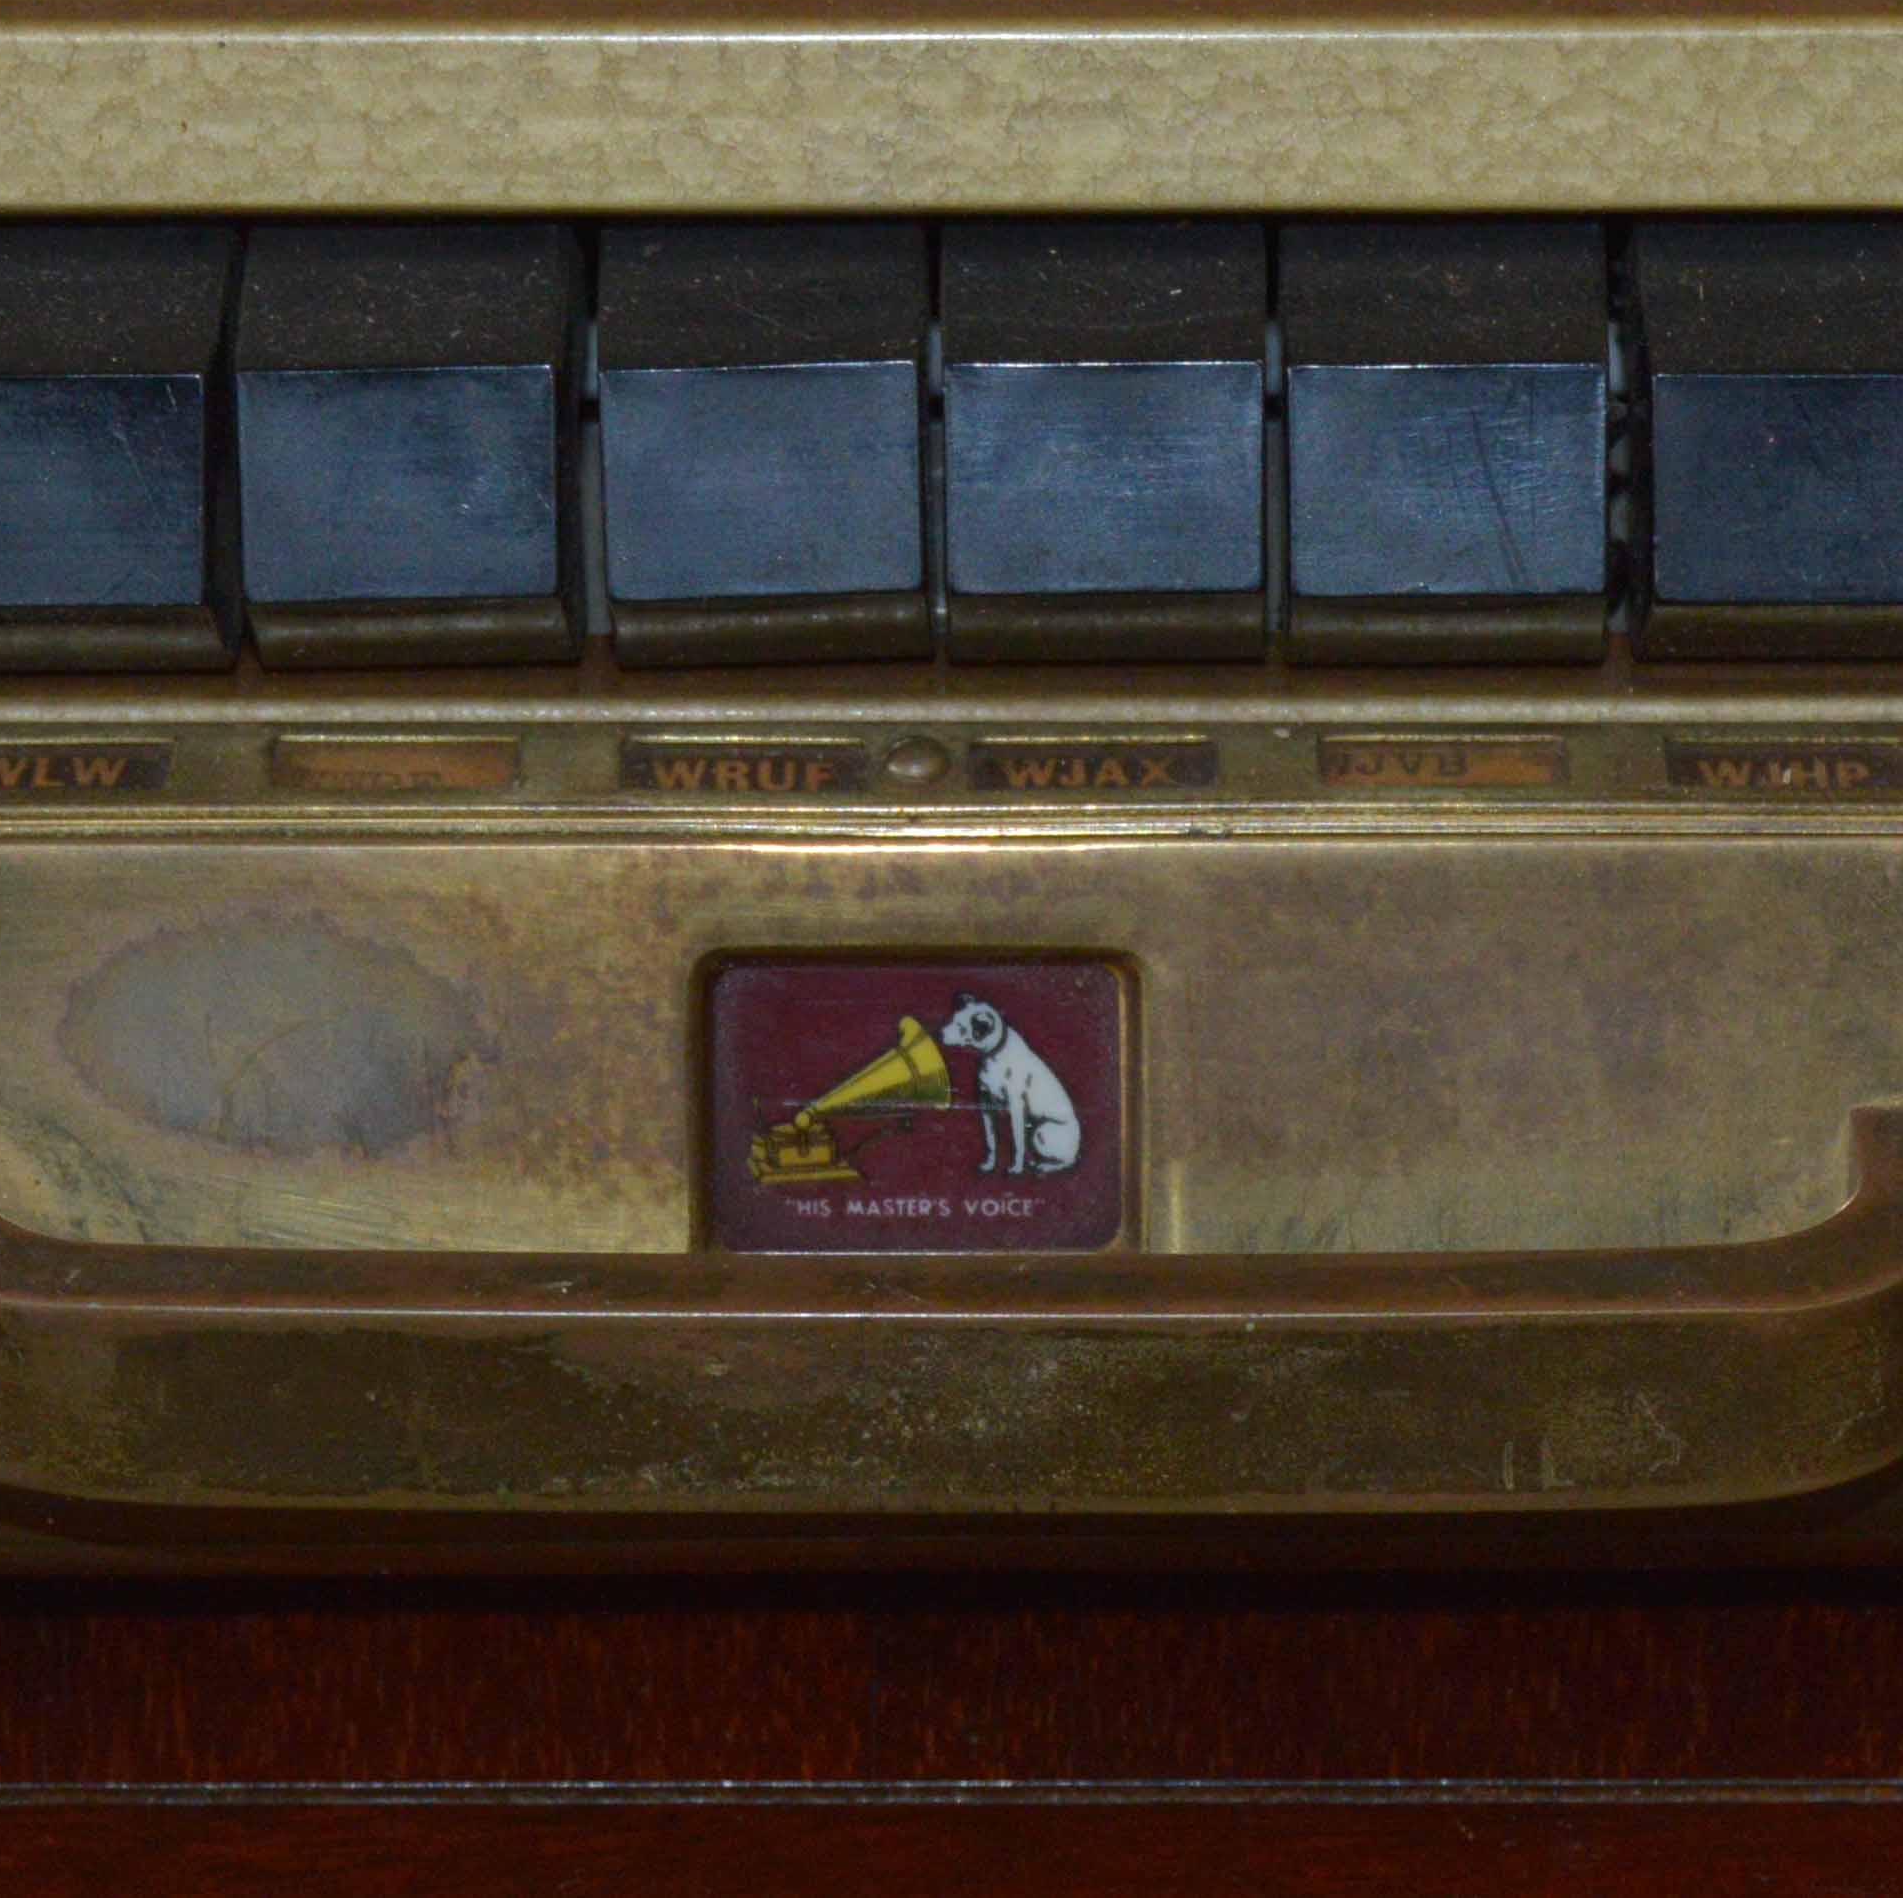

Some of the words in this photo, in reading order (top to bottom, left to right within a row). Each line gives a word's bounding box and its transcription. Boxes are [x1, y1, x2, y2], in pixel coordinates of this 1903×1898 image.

[651, 757, 837, 792] WRUF
[1001, 756, 1174, 789] WJAX
[846, 1199, 952, 1218] MASTER'S
